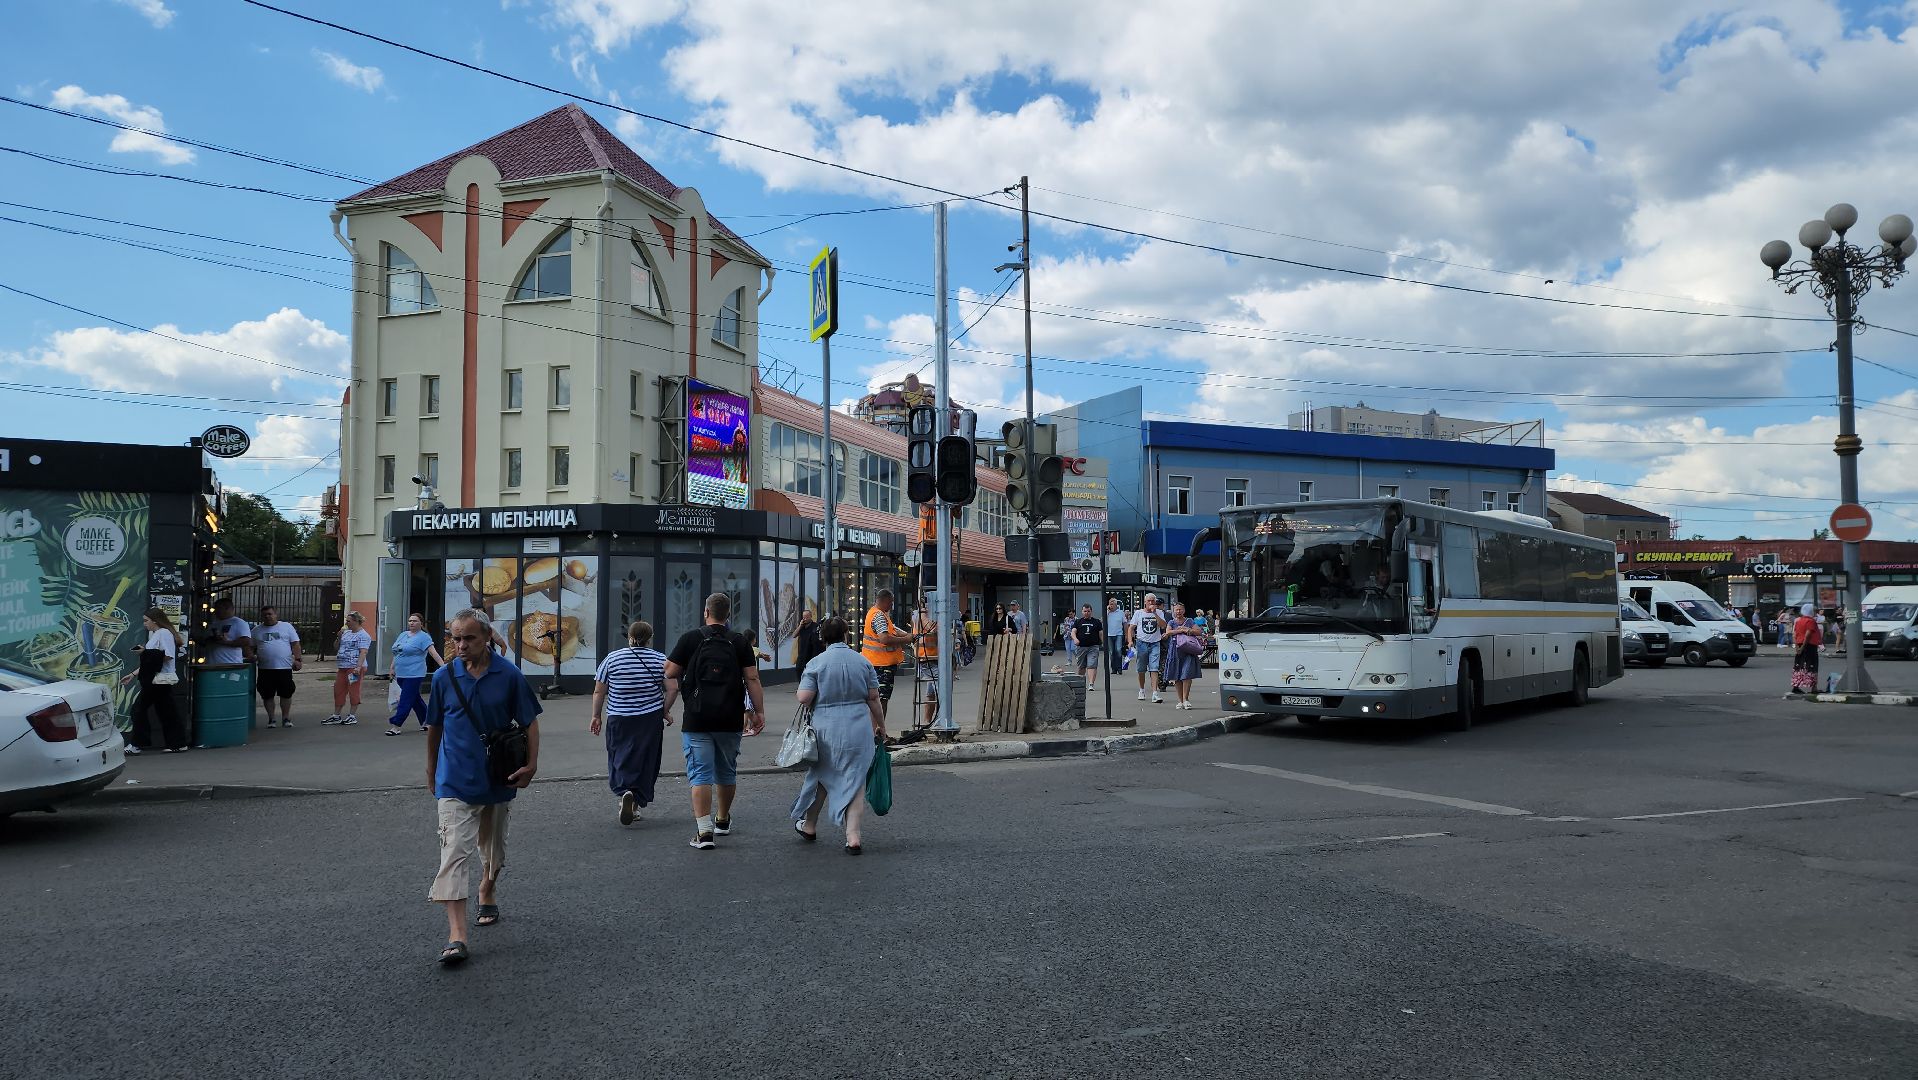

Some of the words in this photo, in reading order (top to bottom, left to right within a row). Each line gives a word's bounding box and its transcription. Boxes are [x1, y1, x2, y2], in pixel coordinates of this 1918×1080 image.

[412, 512, 480, 530] ПЕКАРНЯ
[491, 508, 577, 529] МЕЛЬНИЦА
[80, 527, 111, 539] MAKE
[75, 539, 116, 551] COFFEE
[1754, 562, 1790, 574] cofix
